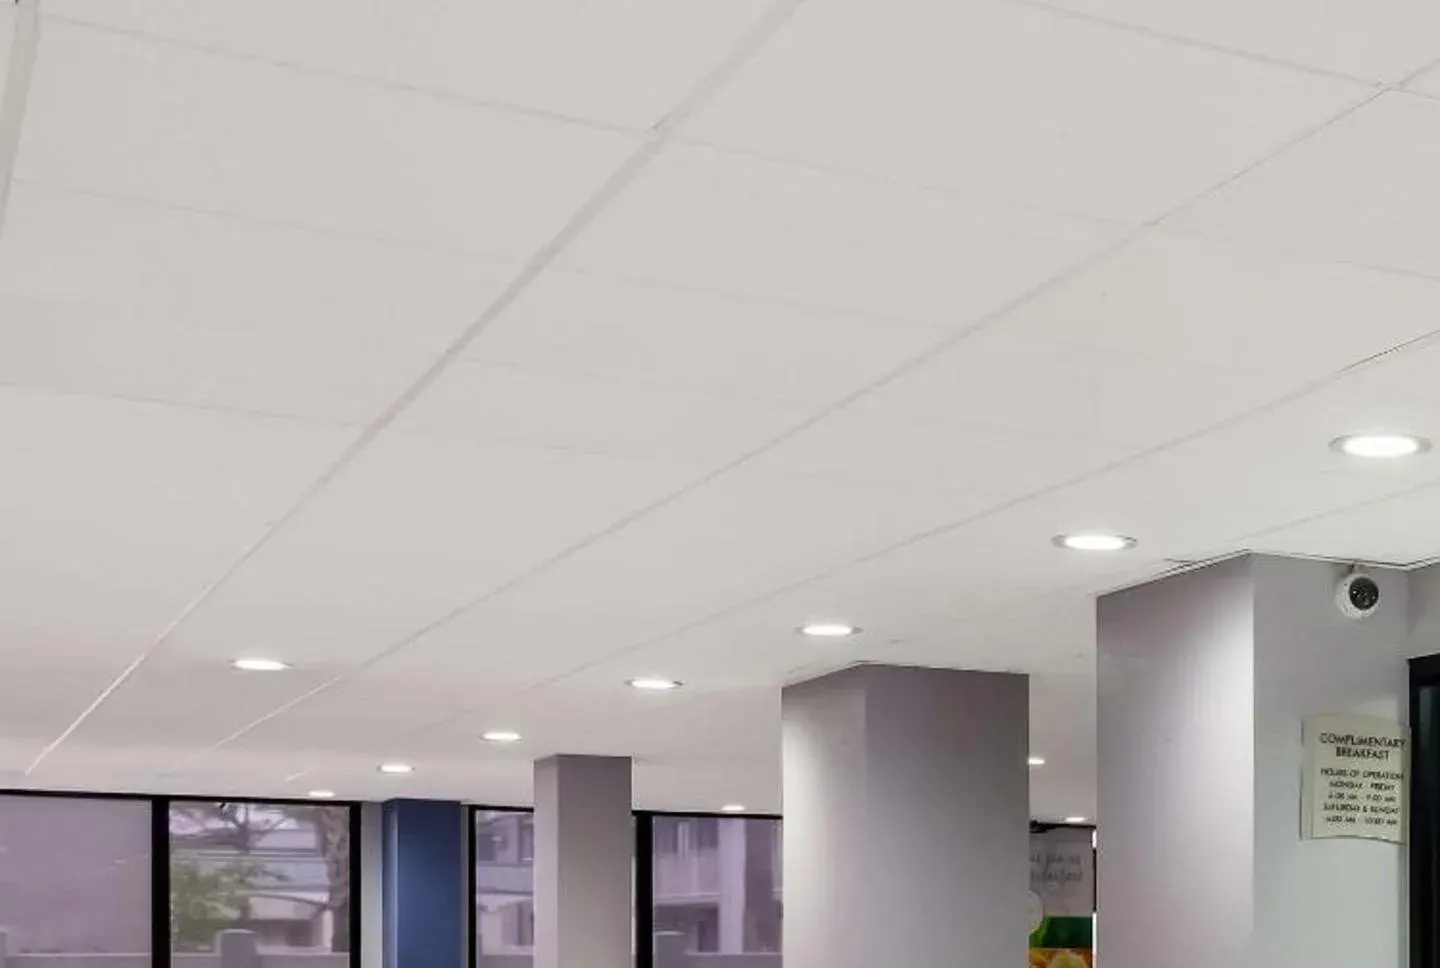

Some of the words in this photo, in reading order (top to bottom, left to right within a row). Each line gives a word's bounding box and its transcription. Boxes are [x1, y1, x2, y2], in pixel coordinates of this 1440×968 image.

[1319, 732, 1406, 748] COMPLIMENTARY
[1335, 746, 1390, 761] BREAKFAST
[1320, 767, 1348, 778] HOURS
[1349, 769, 1360, 778] OF
[1329, 780, 1363, 789] MONDAY
[1370, 782, 1395, 791] FRIDAY
[1323, 803, 1360, 812] SATURDAY
[1370, 805, 1399, 815] SUNDAY
